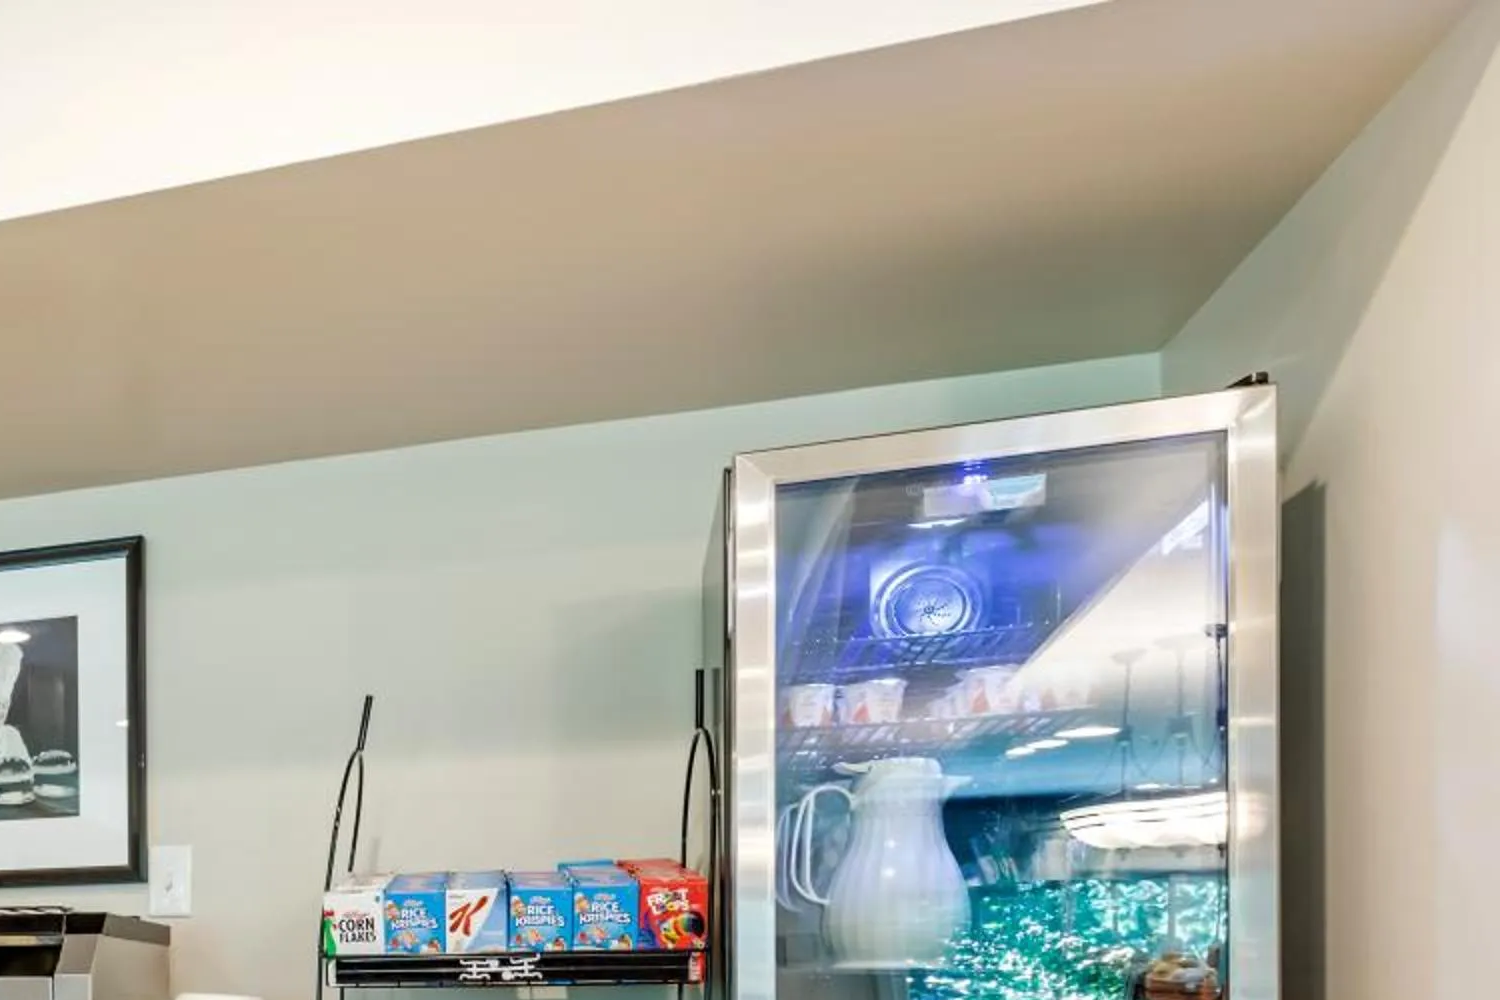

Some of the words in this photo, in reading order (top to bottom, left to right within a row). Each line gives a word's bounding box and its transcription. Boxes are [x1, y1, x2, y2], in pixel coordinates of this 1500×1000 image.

[527, 905, 554, 916] RICE
[591, 901, 620, 913] RICE
[401, 908, 427, 920] RICE
[449, 895, 488, 936] K
[579, 912, 631, 925] KRISPIES
[339, 918, 375, 933] CORN
[515, 915, 565, 927] KRISPIES
[339, 932, 377, 943] FLAKES
